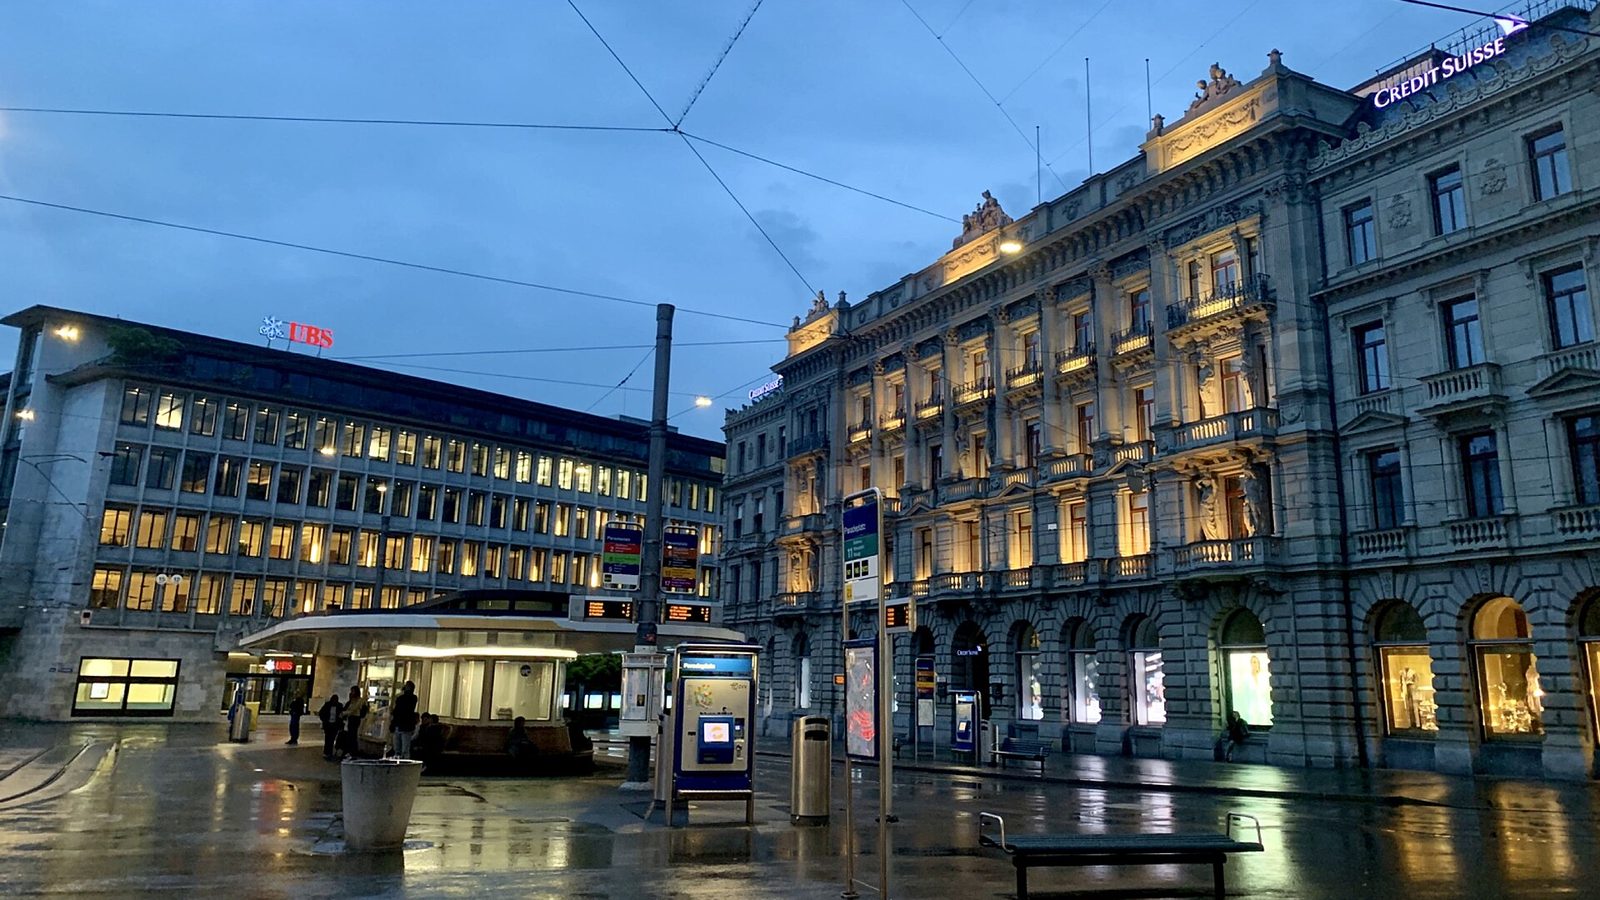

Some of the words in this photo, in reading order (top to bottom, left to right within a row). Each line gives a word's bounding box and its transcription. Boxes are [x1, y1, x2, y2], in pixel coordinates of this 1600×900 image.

[1373, 66, 1440, 108] CREDIT
[1441, 37, 1506, 79] SUISSE
[289, 321, 333, 348] UBS
[275, 660, 293, 670] UBS
